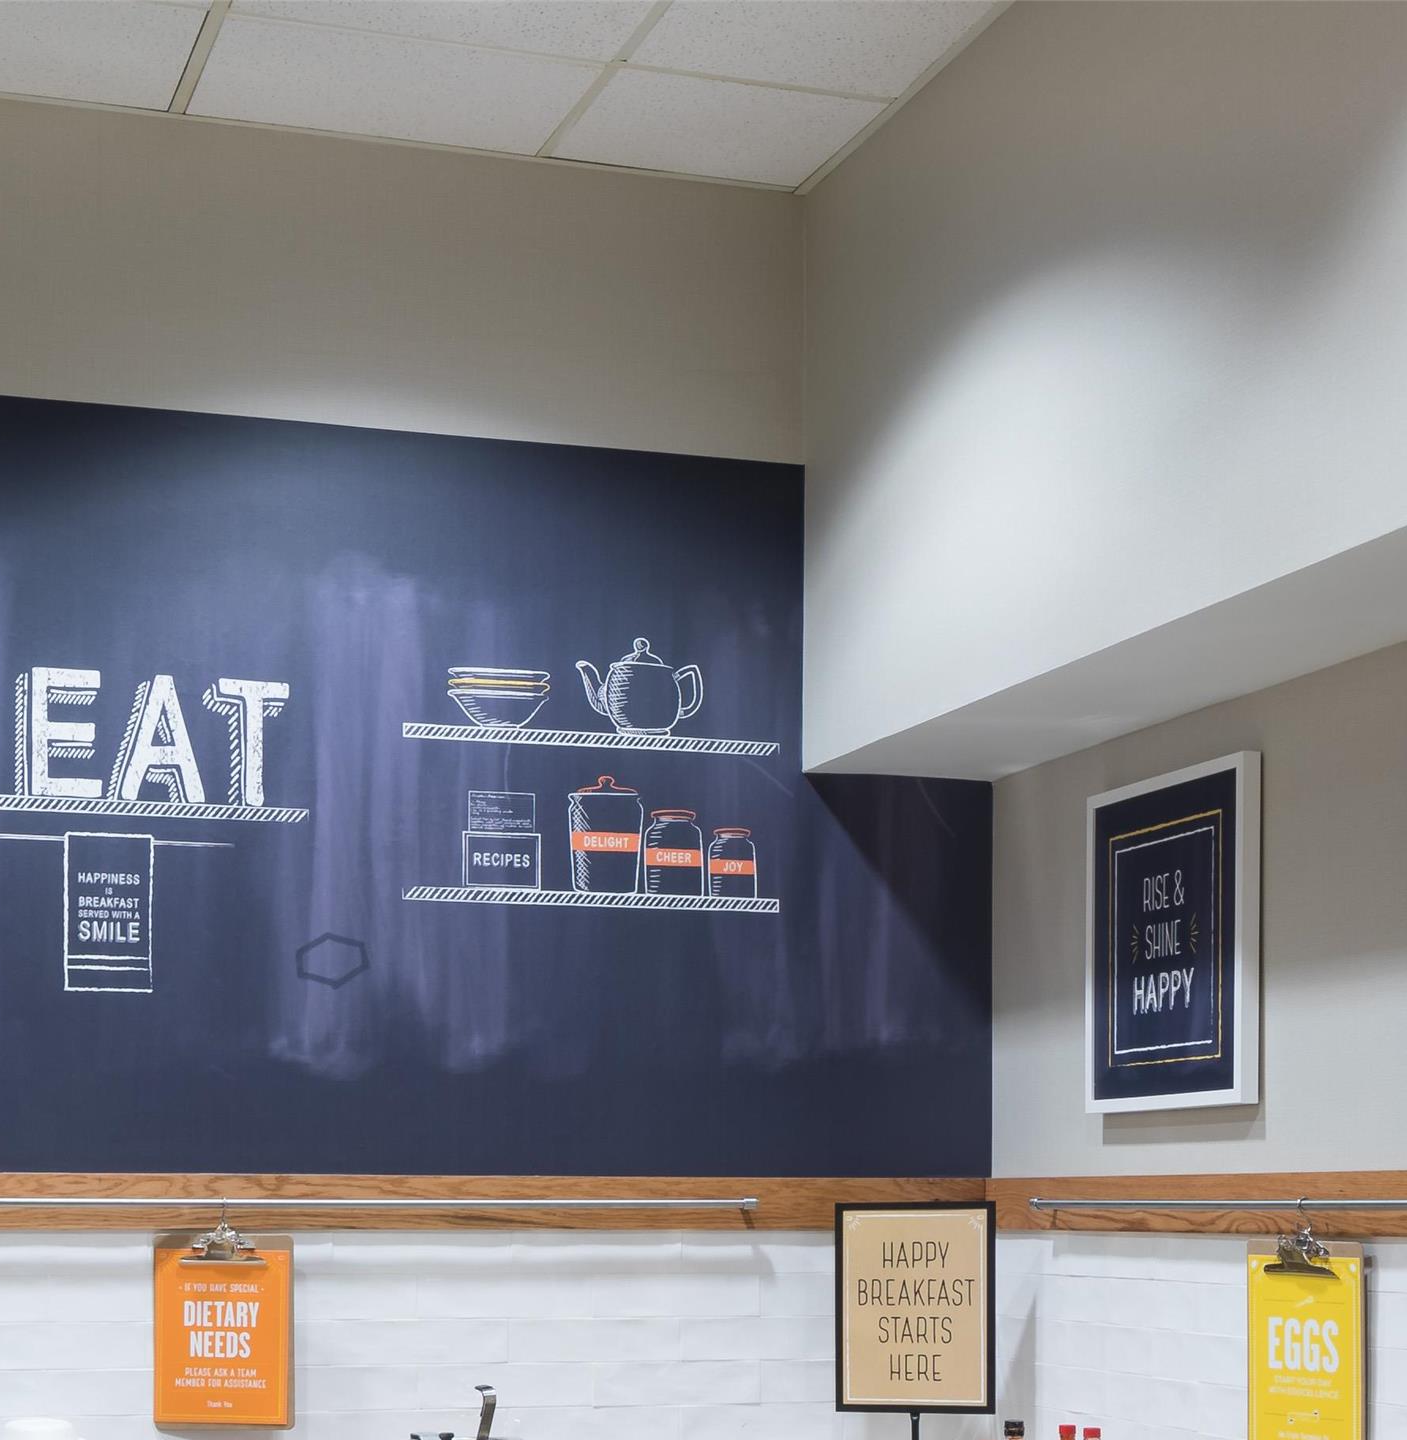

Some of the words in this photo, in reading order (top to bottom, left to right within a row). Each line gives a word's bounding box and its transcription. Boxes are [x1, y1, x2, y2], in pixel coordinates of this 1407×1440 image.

[15, 667, 290, 806] EAT
[583, 836, 629, 849] DELIGHT
[473, 852, 530, 867] RECIPES
[656, 852, 692, 863] CHEER
[722, 861, 743, 872] JOY
[78, 872, 140, 885] HAPPINESS
[1143, 873, 1169, 912] RISE
[1174, 869, 1184, 905] &
[78, 896, 140, 909] BREAKFAST
[78, 910, 109, 918] SERVED
[112, 910, 132, 919] WITH
[78, 921, 140, 943] SMILE
[1145, 919, 1181, 960] SHINE
[1133, 967, 1194, 1015] HAPPY
[883, 1241, 949, 1268] HAPPY
[184, 1284, 191, 1292] IF
[194, 1284, 206, 1292] YOU
[210, 1284, 226, 1292] HAVE
[230, 1284, 258, 1293] SPECIAL
[858, 1279, 975, 1306] BREAKFAST
[184, 1301, 259, 1327] DIETARY
[878, 1317, 952, 1344] STARTS
[190, 1331, 250, 1358] NEEDS
[1268, 1317, 1339, 1373] EGGS
[185, 1368, 211, 1376] PLEASE
[214, 1368, 227, 1376] ASK
[238, 1369, 256, 1377] TEAM
[890, 1354, 942, 1381] HERE
[175, 1378, 204, 1387] MEMBER
[208, 1379, 221, 1387] FOR
[224, 1380, 266, 1388] ASSISTANCE
